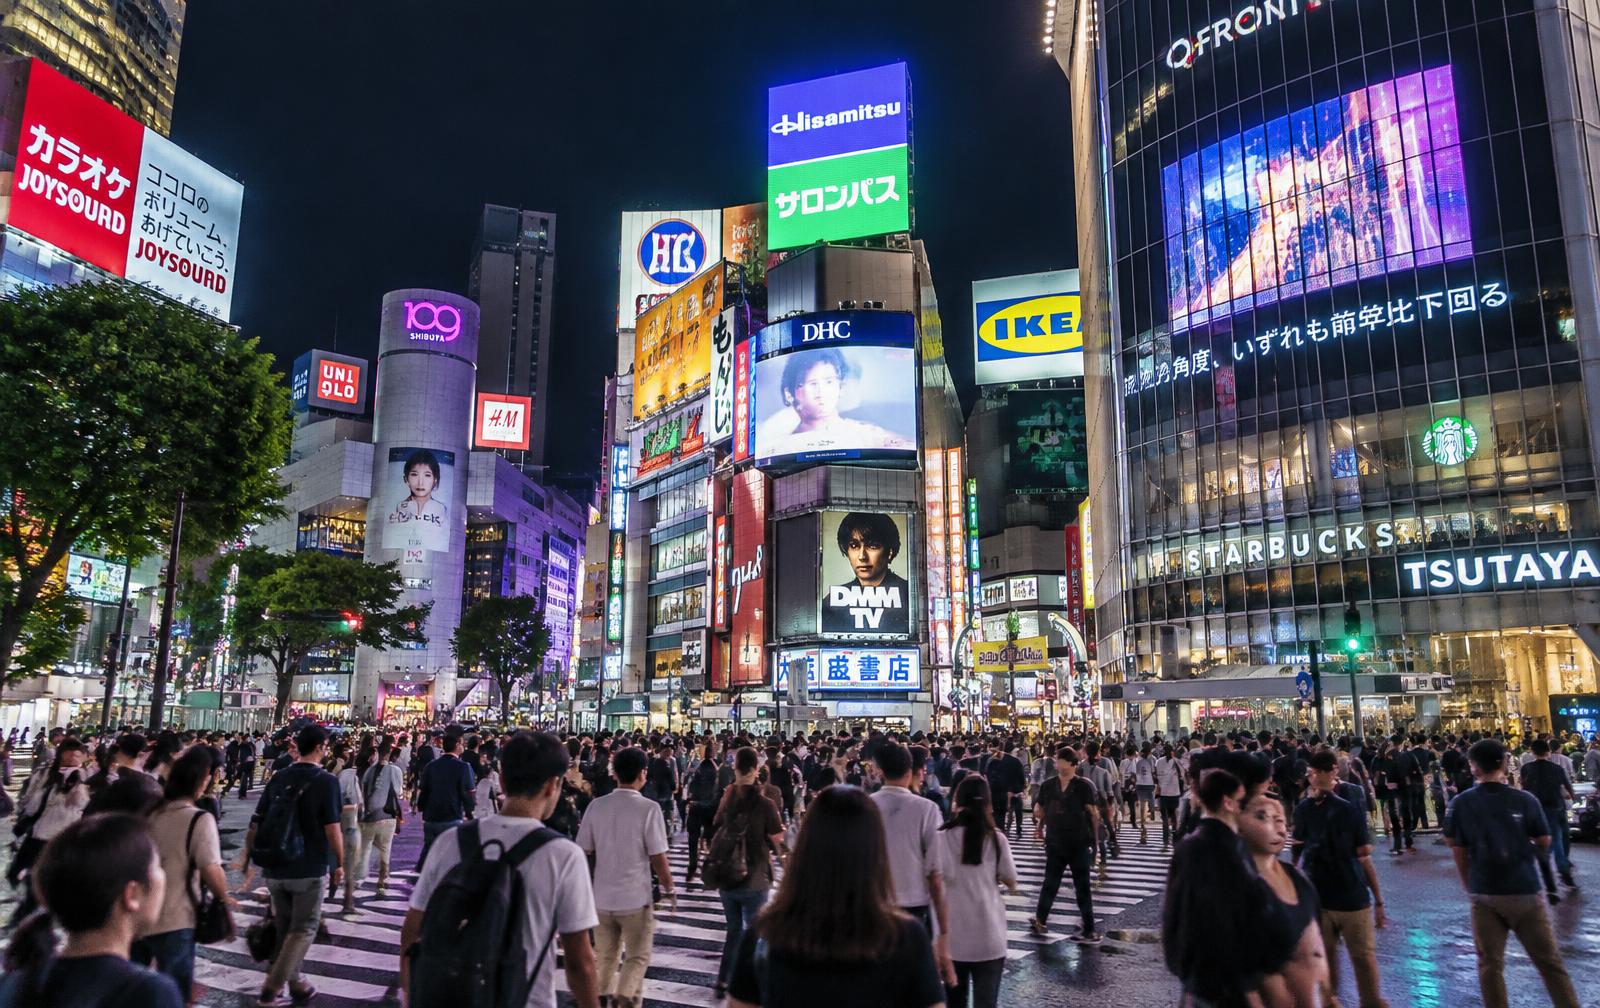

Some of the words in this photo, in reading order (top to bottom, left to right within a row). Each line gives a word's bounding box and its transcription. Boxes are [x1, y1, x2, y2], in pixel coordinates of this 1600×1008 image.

[771, 101, 900, 136] Hisamitsu
[26, 123, 131, 200] カラオケ
[146, 163, 209, 214] ココロの
[775, 175, 900, 218] サロンパス
[404, 301, 461, 342] 109
[410, 332, 445, 343] SHIBUYA
[802, 320, 851, 342] DHC
[995, 311, 1083, 341] IKE
[321, 380, 355, 399] QLO
[323, 365, 354, 384] UNI
[1186, 522, 1395, 572] STARBUCKS
[1403, 549, 1600, 590] TSUTAYA
[830, 585, 902, 608] DMM
[849, 607, 885, 629] TV
